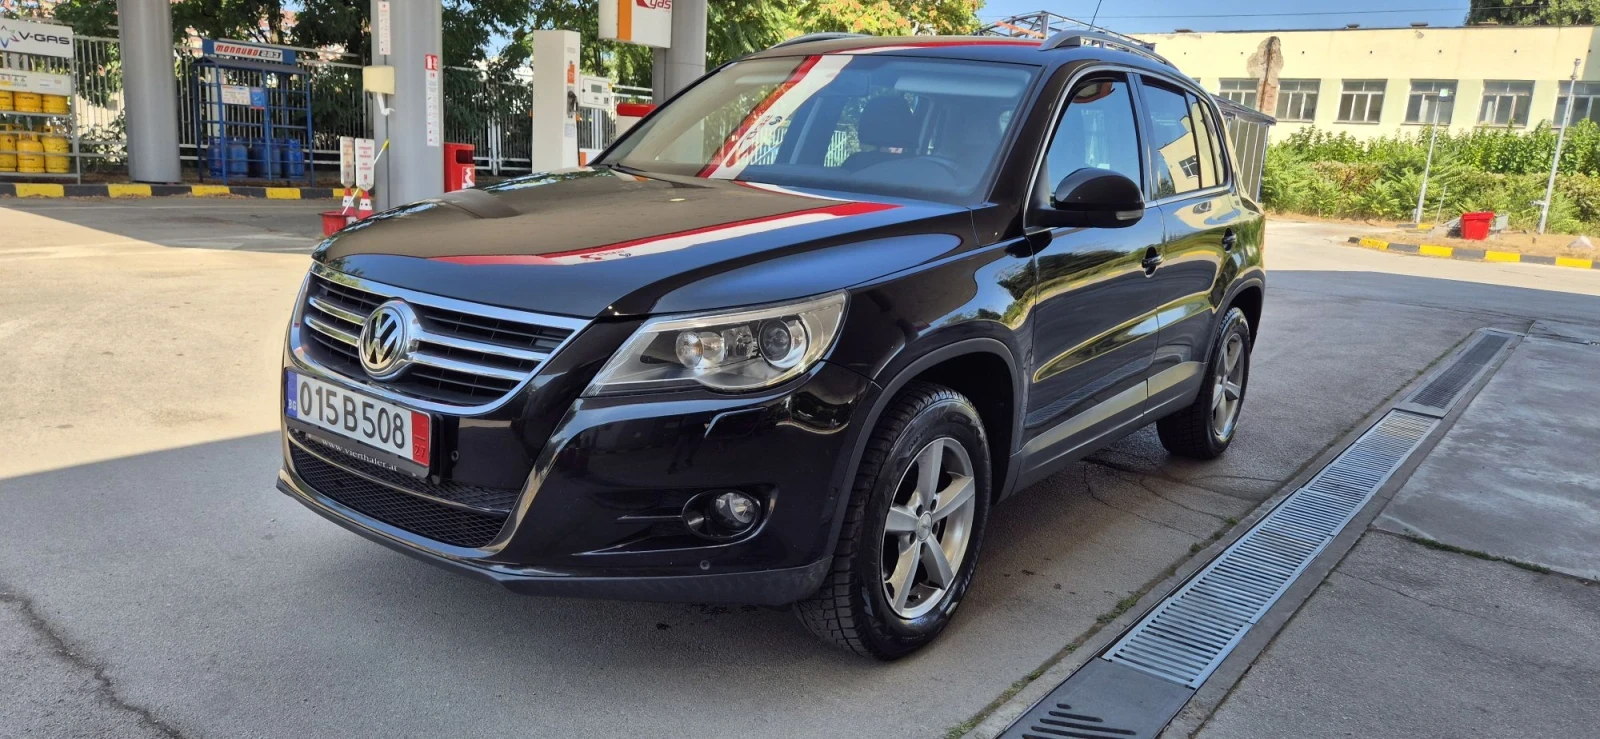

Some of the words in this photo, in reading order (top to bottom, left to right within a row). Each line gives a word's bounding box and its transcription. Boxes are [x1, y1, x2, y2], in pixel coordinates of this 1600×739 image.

[18, 31, 70, 45] V-GAS
[288, 399, 297, 411] BG
[300, 381, 405, 449] 015B508
